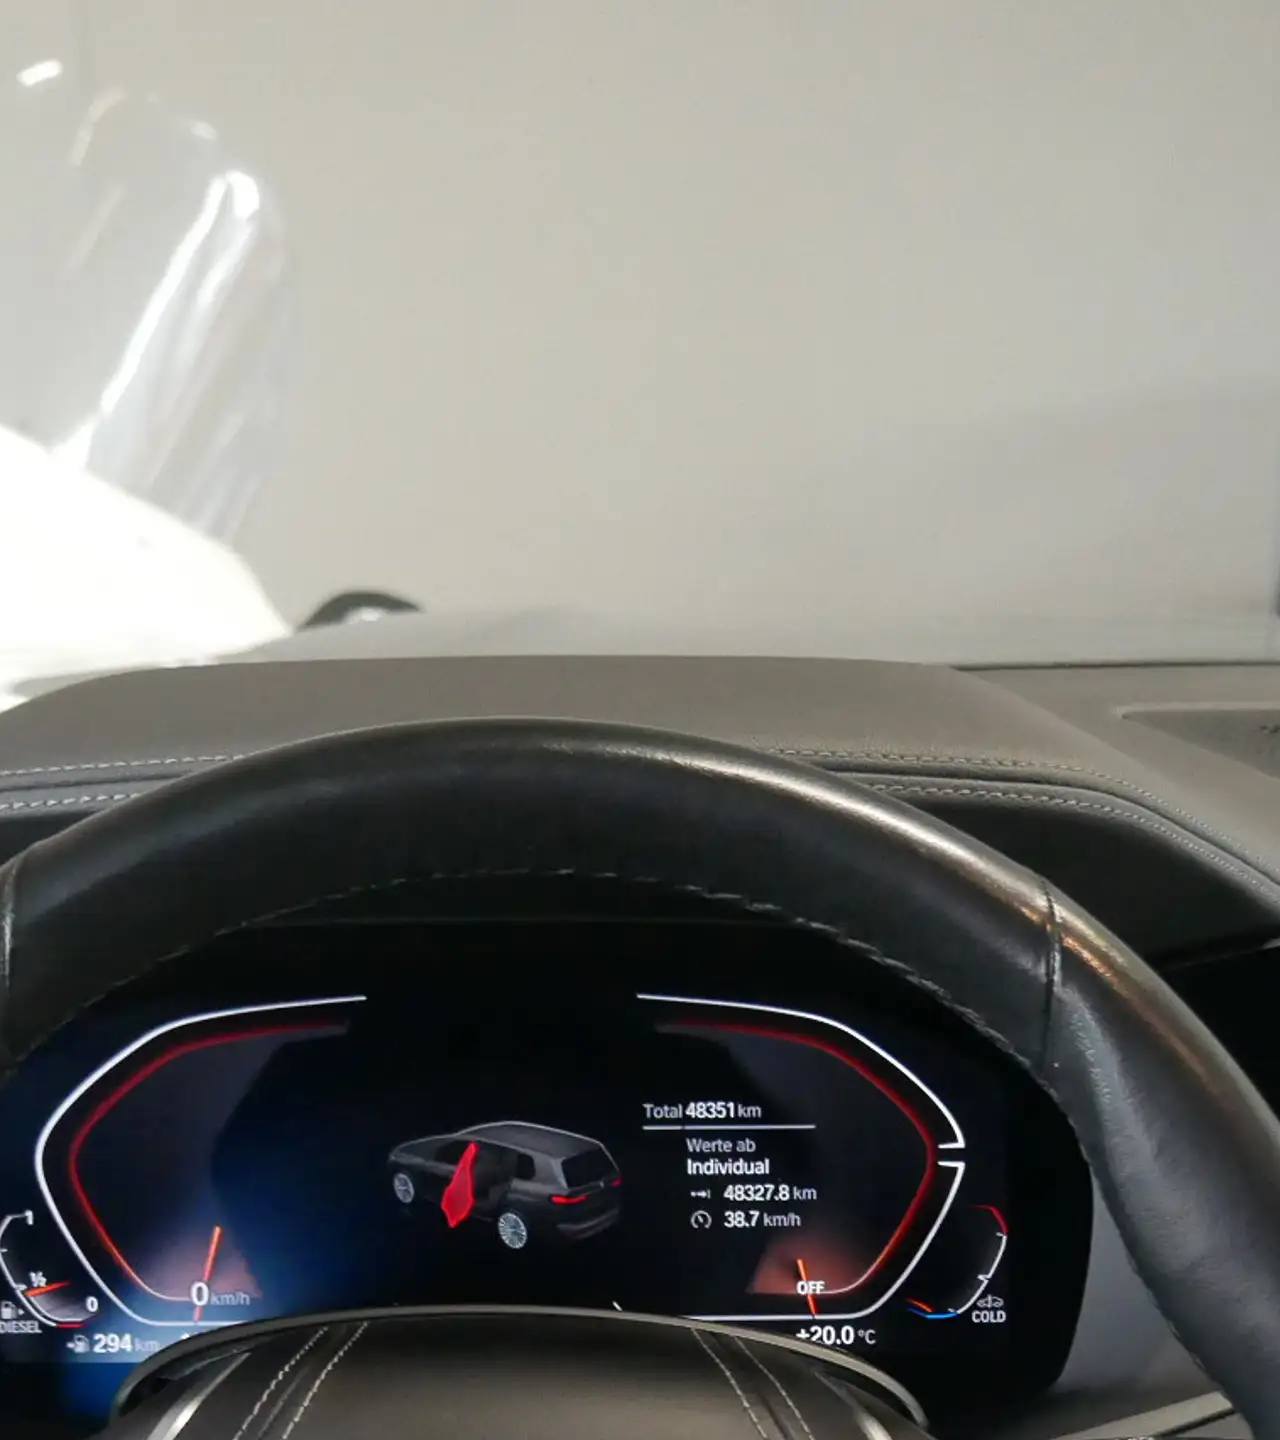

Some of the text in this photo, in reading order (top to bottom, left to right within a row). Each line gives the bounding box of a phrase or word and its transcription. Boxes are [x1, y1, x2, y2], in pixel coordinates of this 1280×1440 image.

[643, 1102, 762, 1119] Total 48351 km
[686, 1138, 756, 1153] Werte ab
[686, 1158, 770, 1176] Individual
[723, 1184, 818, 1202] 48327.8 km
[26, 1210, 35, 1226] 1
[723, 1210, 802, 1229] 38.7 km/h
[190, 1281, 251, 1306] 0 km/h
[796, 1280, 825, 1296] OFF
[86, 1296, 99, 1312] 0
[971, 1310, 1007, 1324] COLD
[93, 1333, 161, 1353] 294 km
[796, 1325, 877, 1346] +20.0 °C
